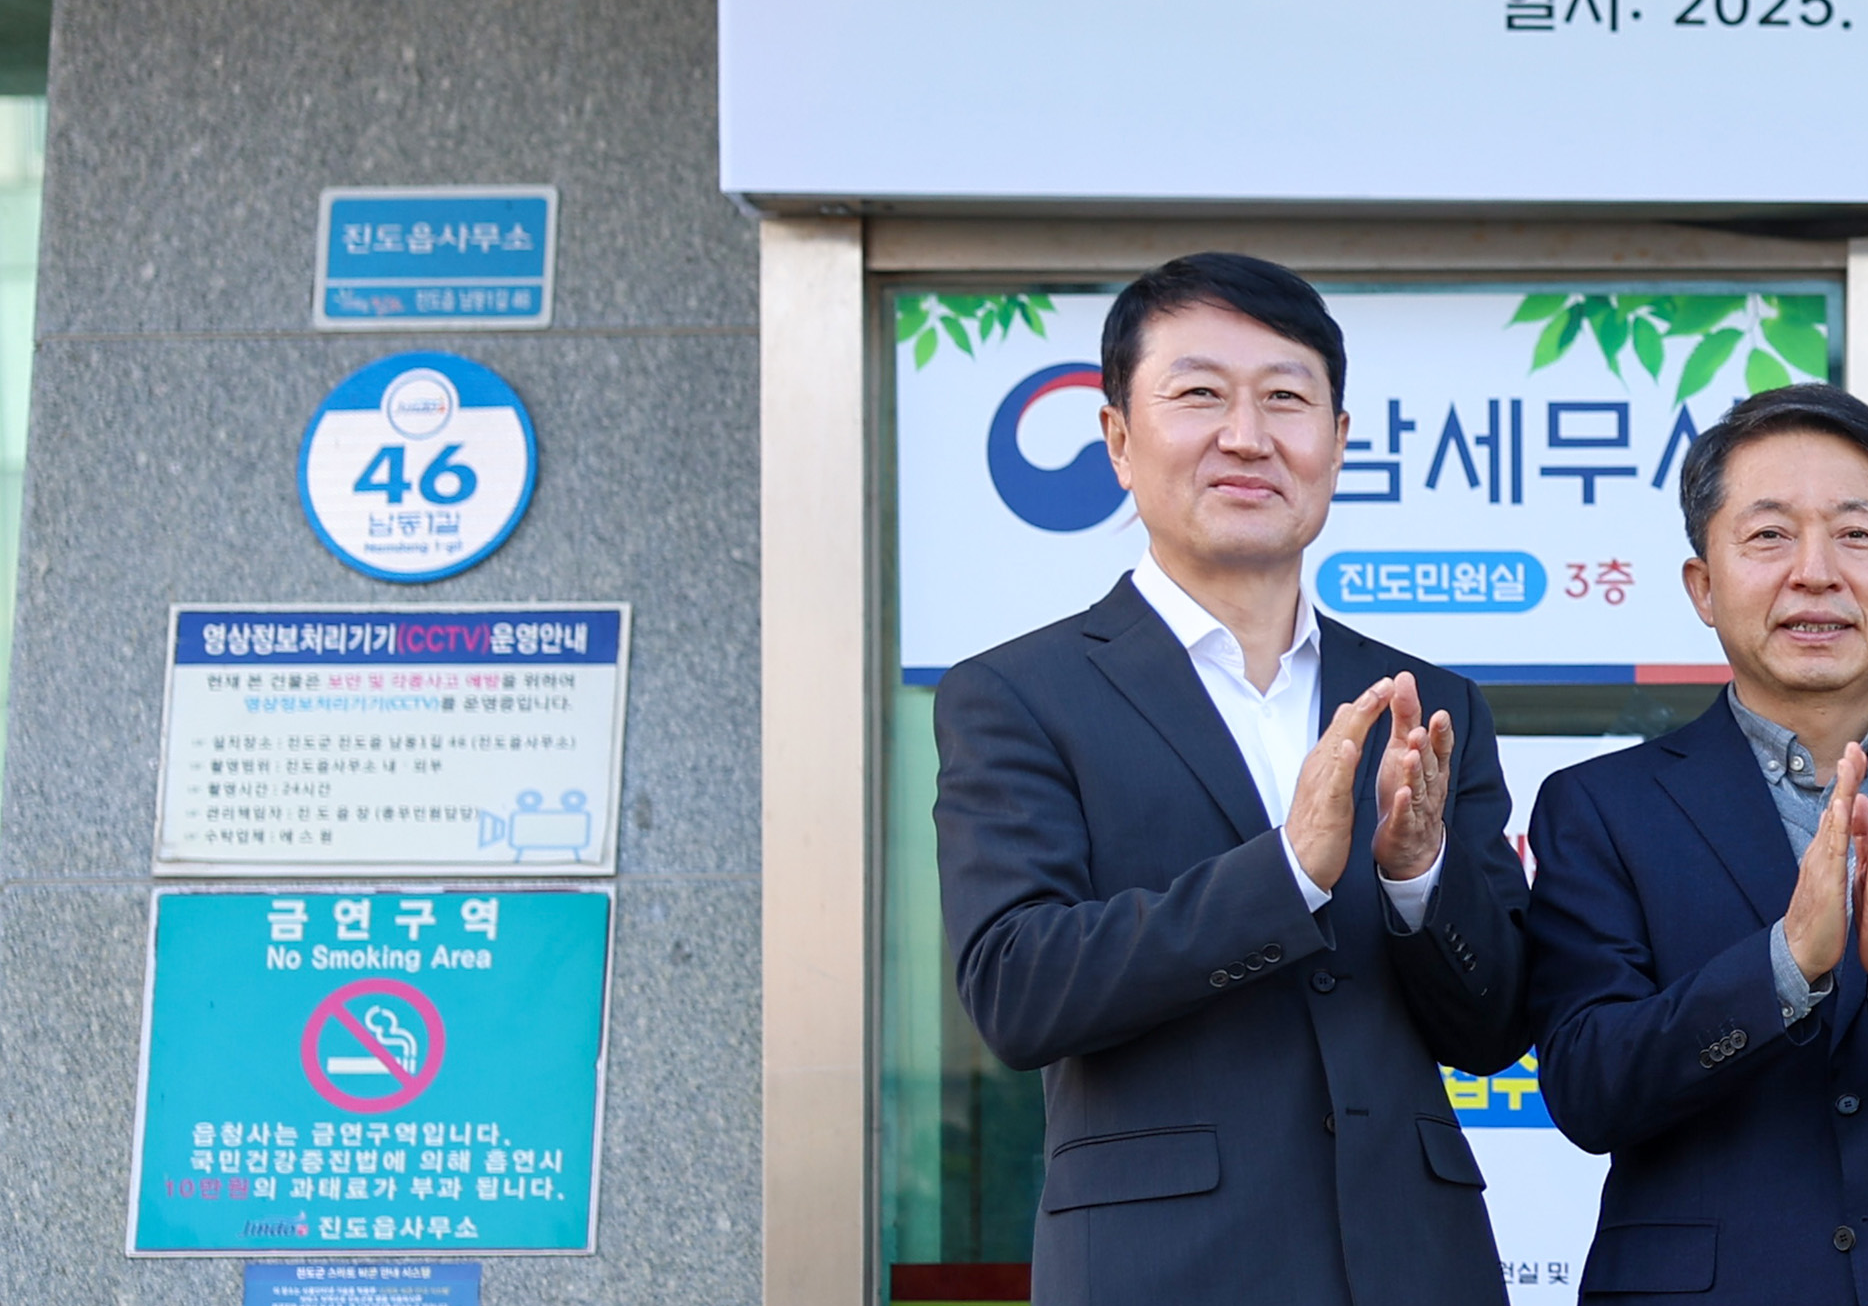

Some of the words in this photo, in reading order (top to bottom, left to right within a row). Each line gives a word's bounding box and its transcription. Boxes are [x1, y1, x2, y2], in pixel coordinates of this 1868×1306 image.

[342, 222, 534, 255] 진도읍사무소
[353, 441, 478, 506] 46
[1338, 562, 1526, 603] 진도민원실
[1564, 558, 1636, 606] 3층
[267, 944, 302, 970] No
[311, 943, 422, 974] Smoking
[430, 943, 492, 970] Area
[192, 1121, 298, 1147] 읍청사는
[312, 1121, 512, 1147] 금연구역입니다.
[190, 1148, 406, 1174] 국민건강증진법에
[419, 1148, 471, 1174] 의해
[485, 1148, 563, 1173] 흡연시
[290, 1175, 398, 1201] 과태료가
[410, 1175, 463, 1201] 부과
[476, 1175, 565, 1201] 됩니다.
[319, 1215, 479, 1240] 진도읍사무소
[1548, 1261, 1569, 1285] 및
